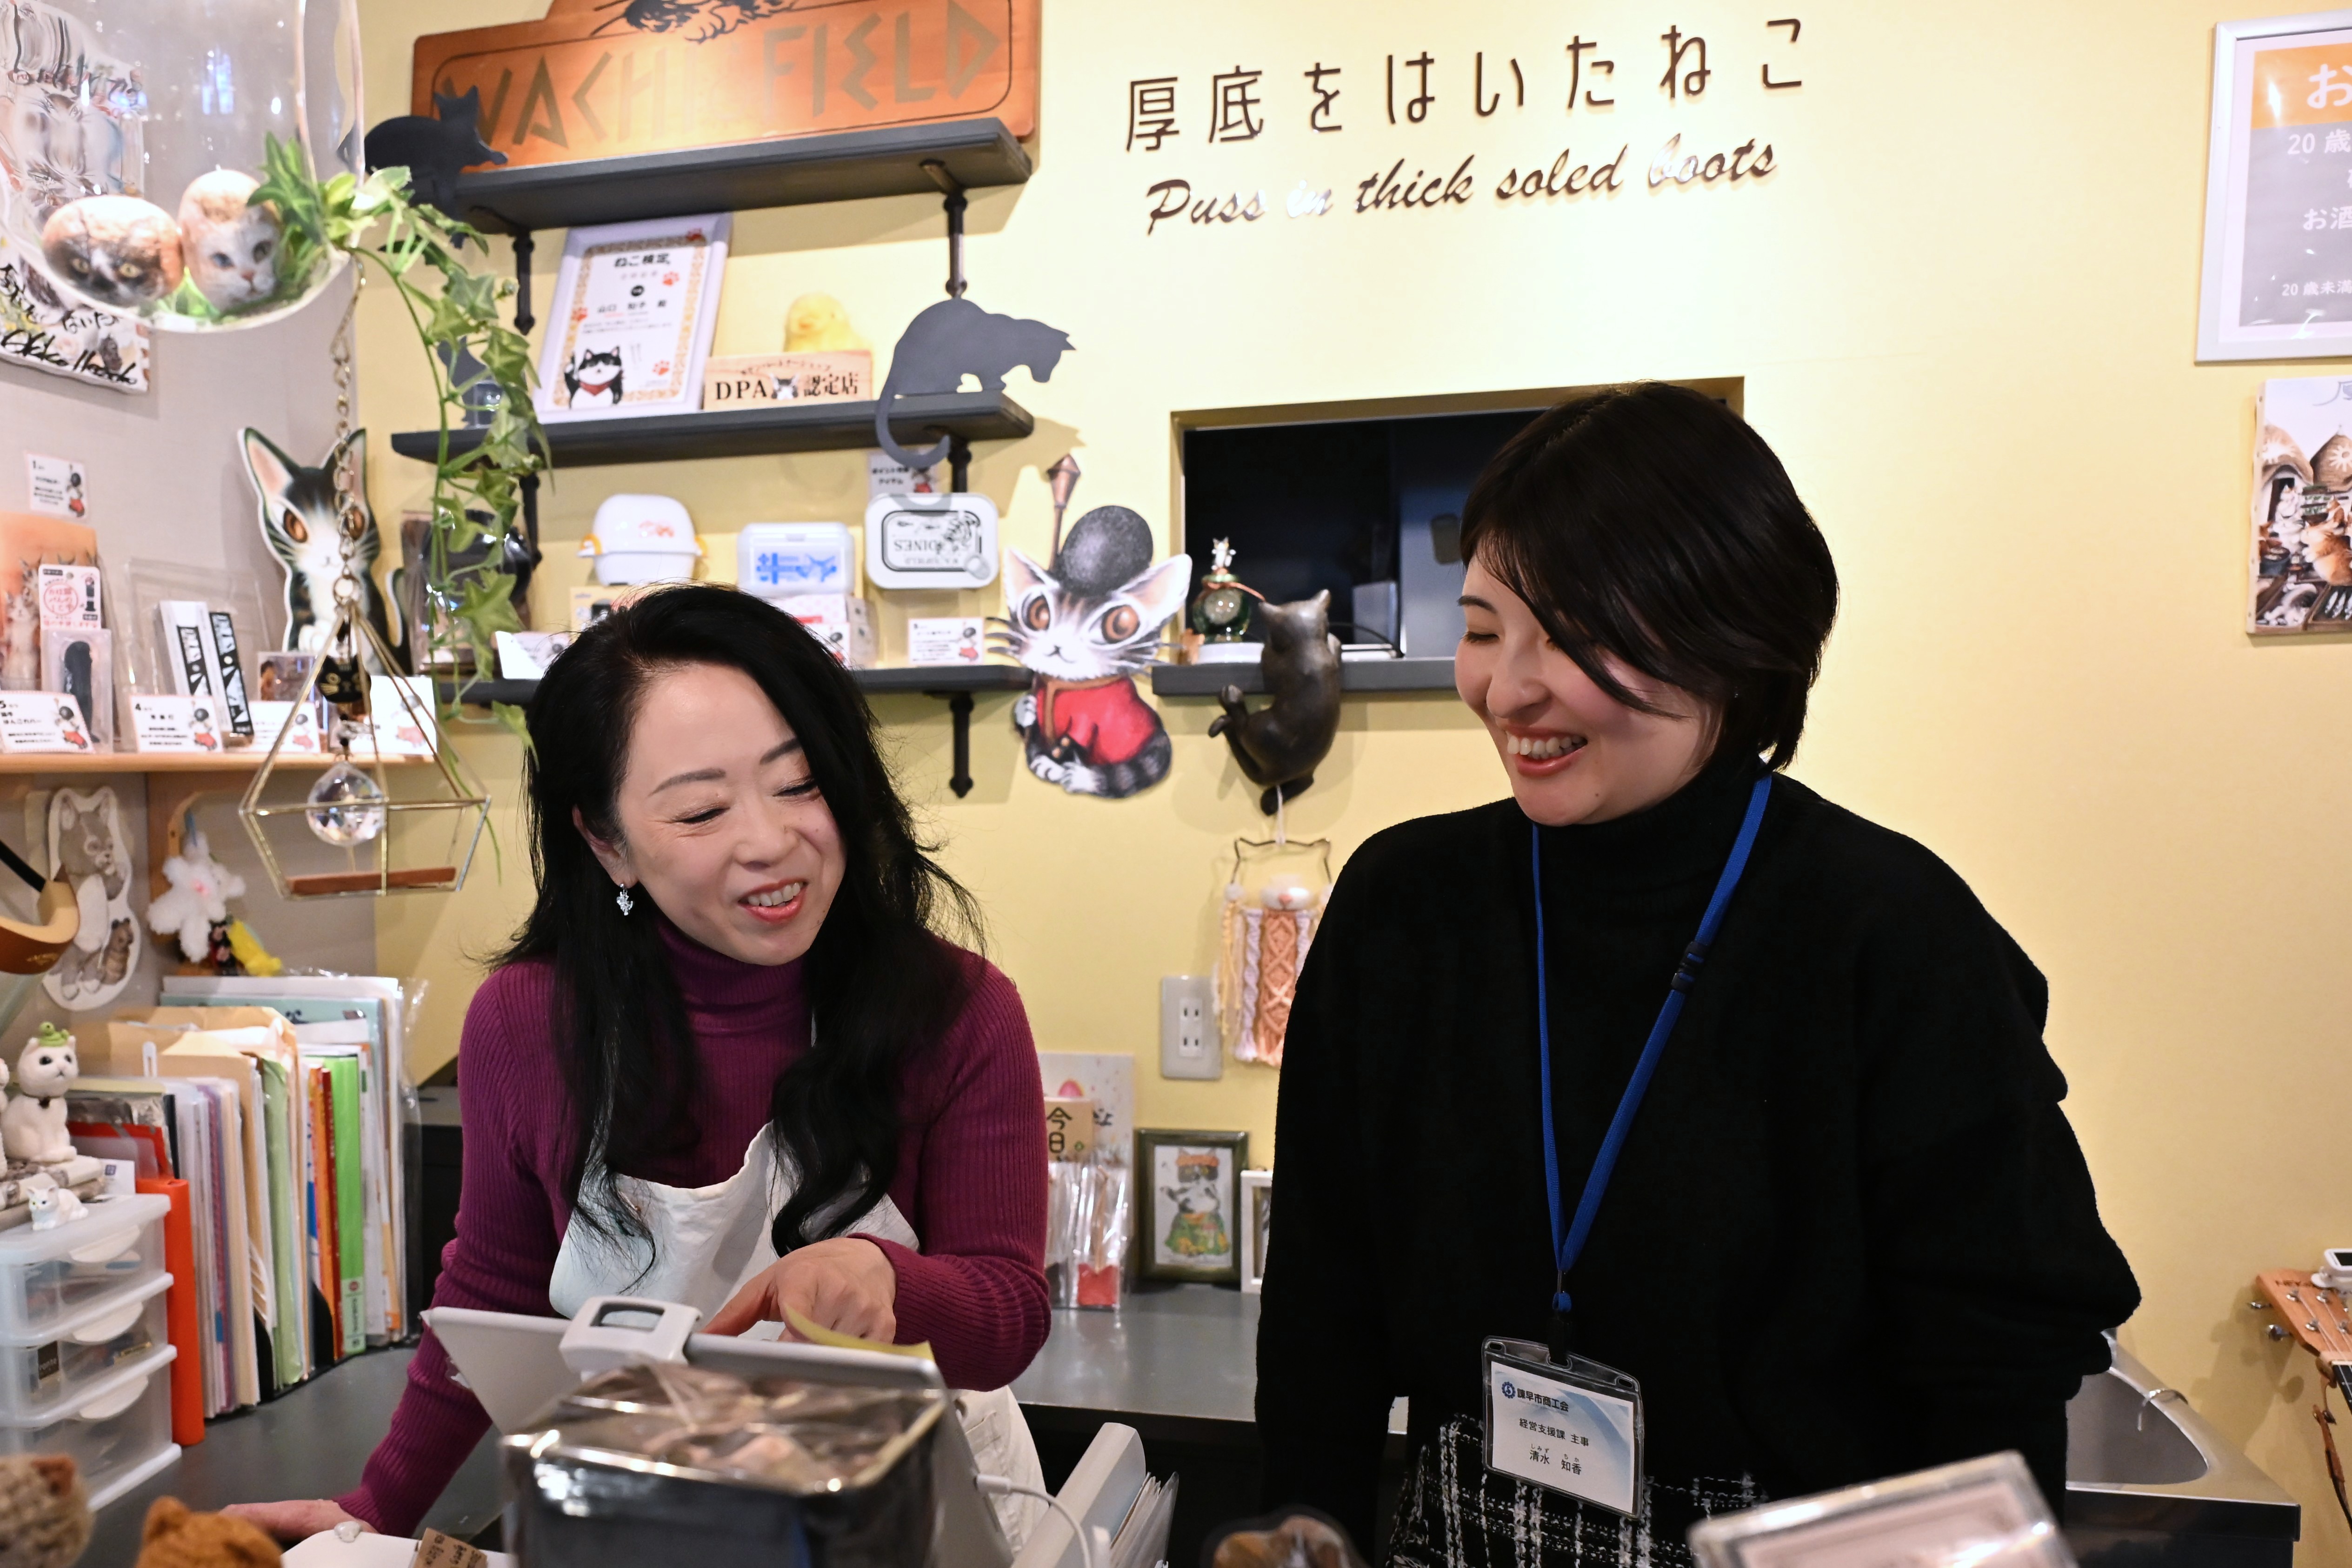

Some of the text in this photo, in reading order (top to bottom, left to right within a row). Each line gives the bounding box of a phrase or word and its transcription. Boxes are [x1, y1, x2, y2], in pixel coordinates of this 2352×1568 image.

[1126, 18, 1802, 153] 厚底をはいたねこ
[1146, 133, 1777, 236] Puss in thick soled boots
[715, 371, 859, 400] DPA 認定店
[1046, 1107, 1073, 1162] 今日
[1519, 1418, 1589, 1447] 経営支援課 主事
[1529, 1449, 1582, 1475] 清水 知香
[1531, 1443, 1580, 1462] しみず ちか
